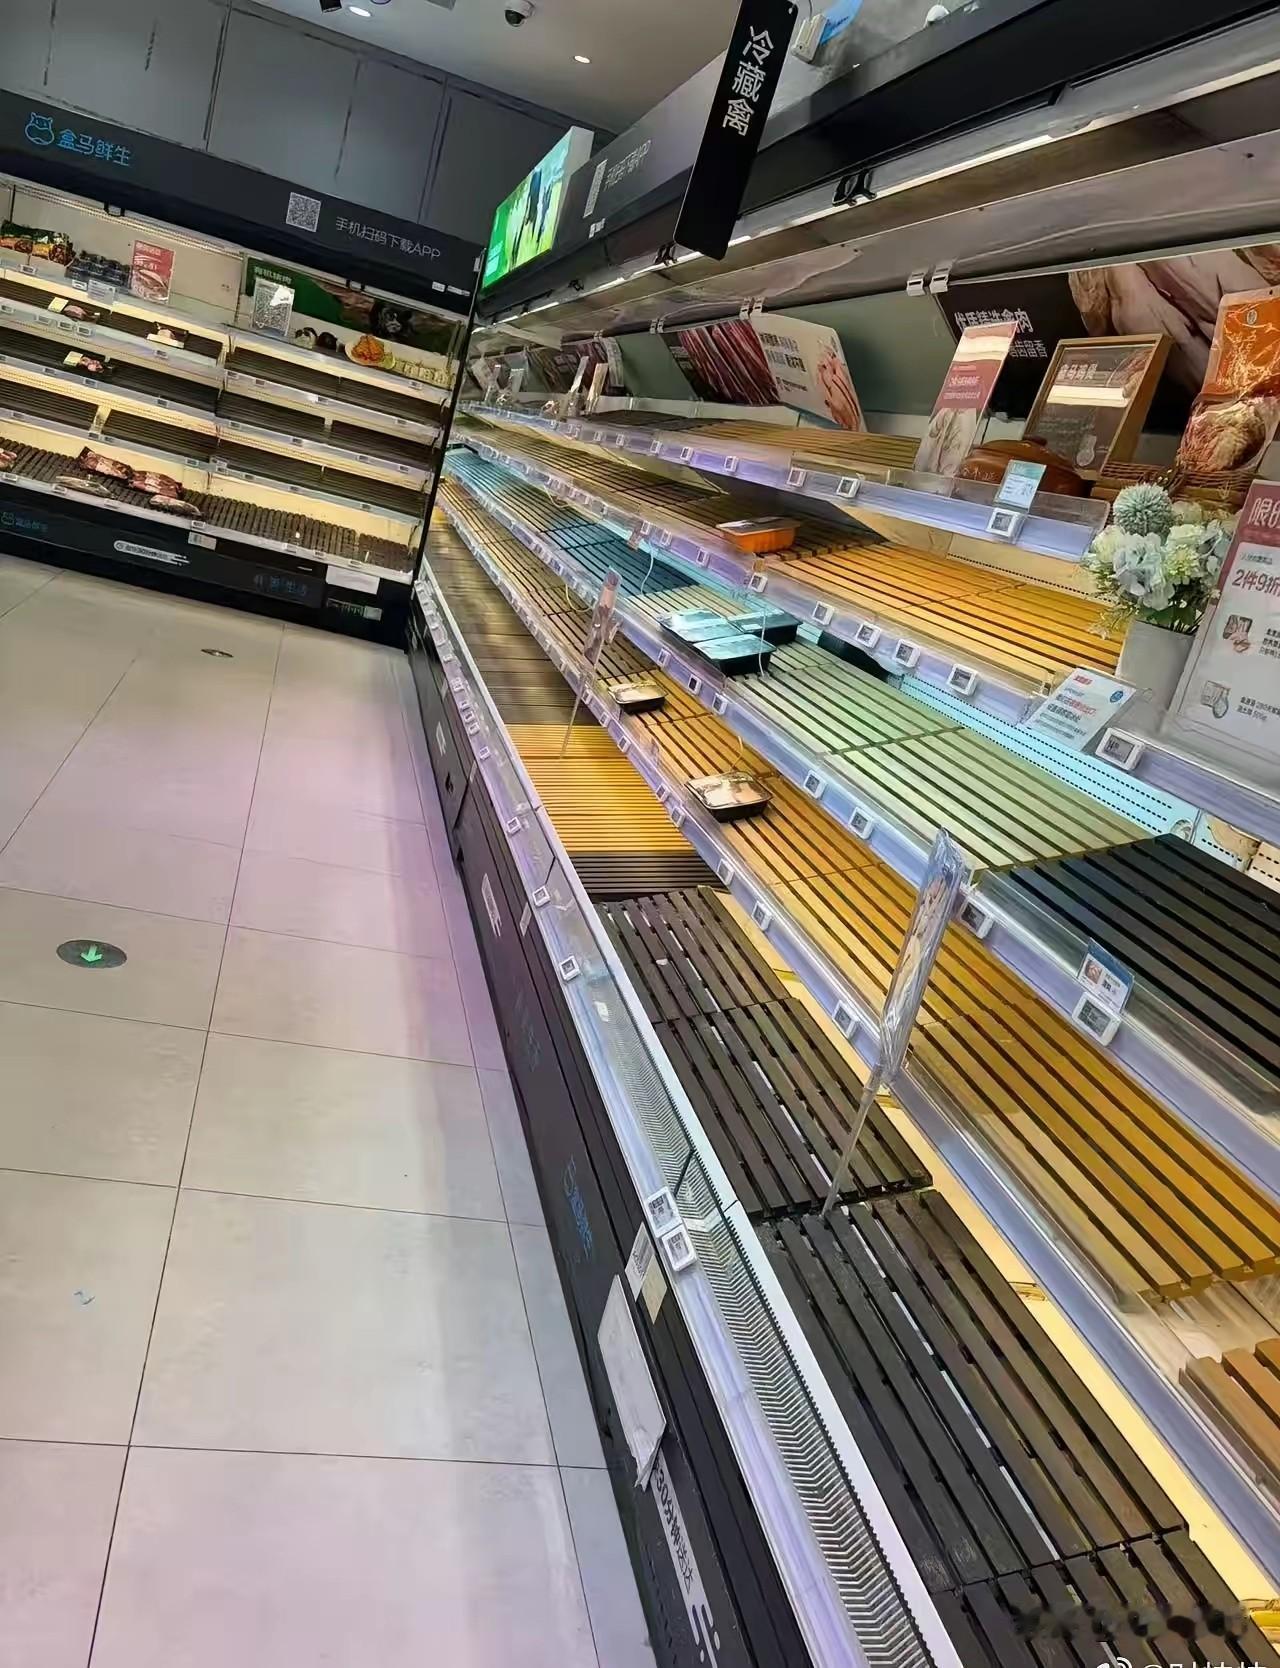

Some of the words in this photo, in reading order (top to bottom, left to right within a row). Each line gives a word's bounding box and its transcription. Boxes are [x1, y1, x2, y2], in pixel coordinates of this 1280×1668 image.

[721, 25, 774, 136] 冷藏禽
[57, 128, 130, 167] 盒马鲜生
[336, 216, 441, 259] 手机扫码下载APP
